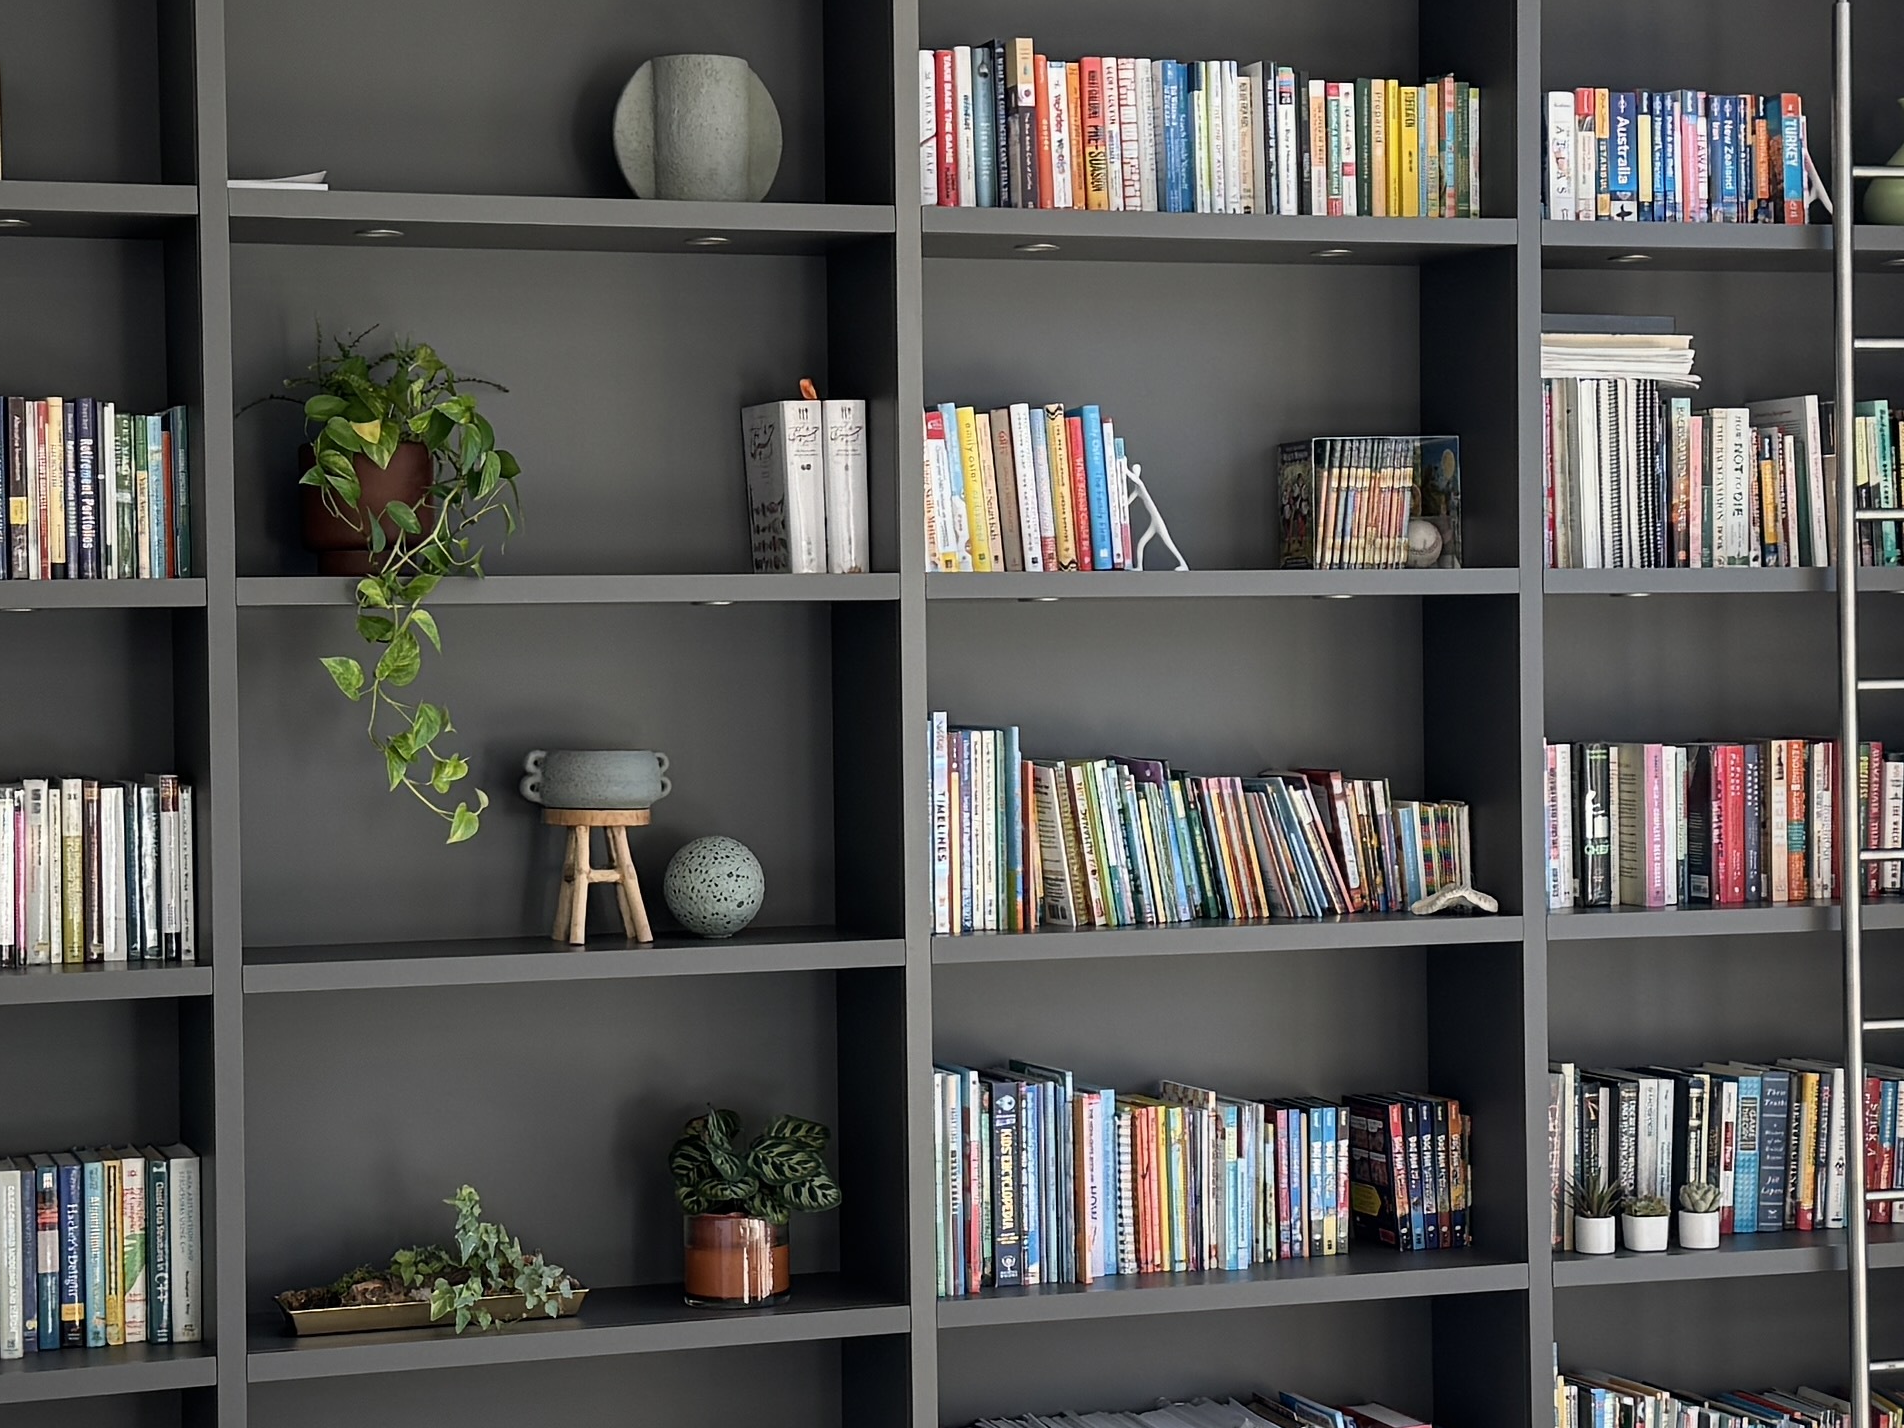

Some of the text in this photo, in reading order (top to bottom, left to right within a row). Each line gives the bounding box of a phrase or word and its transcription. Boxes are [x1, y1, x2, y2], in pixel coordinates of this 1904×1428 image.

[1089, 125, 1105, 191] PRE-SUASION
[1555, 126, 1566, 193] ATLAS
[1616, 116, 1630, 183] Australia
[1724, 120, 1733, 143] New
[1785, 120, 1798, 166] TURKEY
[80, 438, 96, 548] Retirement Portfolios
[1733, 443, 1744, 516] NOT DIE
[937, 791, 947, 861] TIMELINES
[1000, 1129, 1013, 1229] KIDS ENCYCLOPEDIA
[65, 1204, 78, 1297] Hacker's Delight
